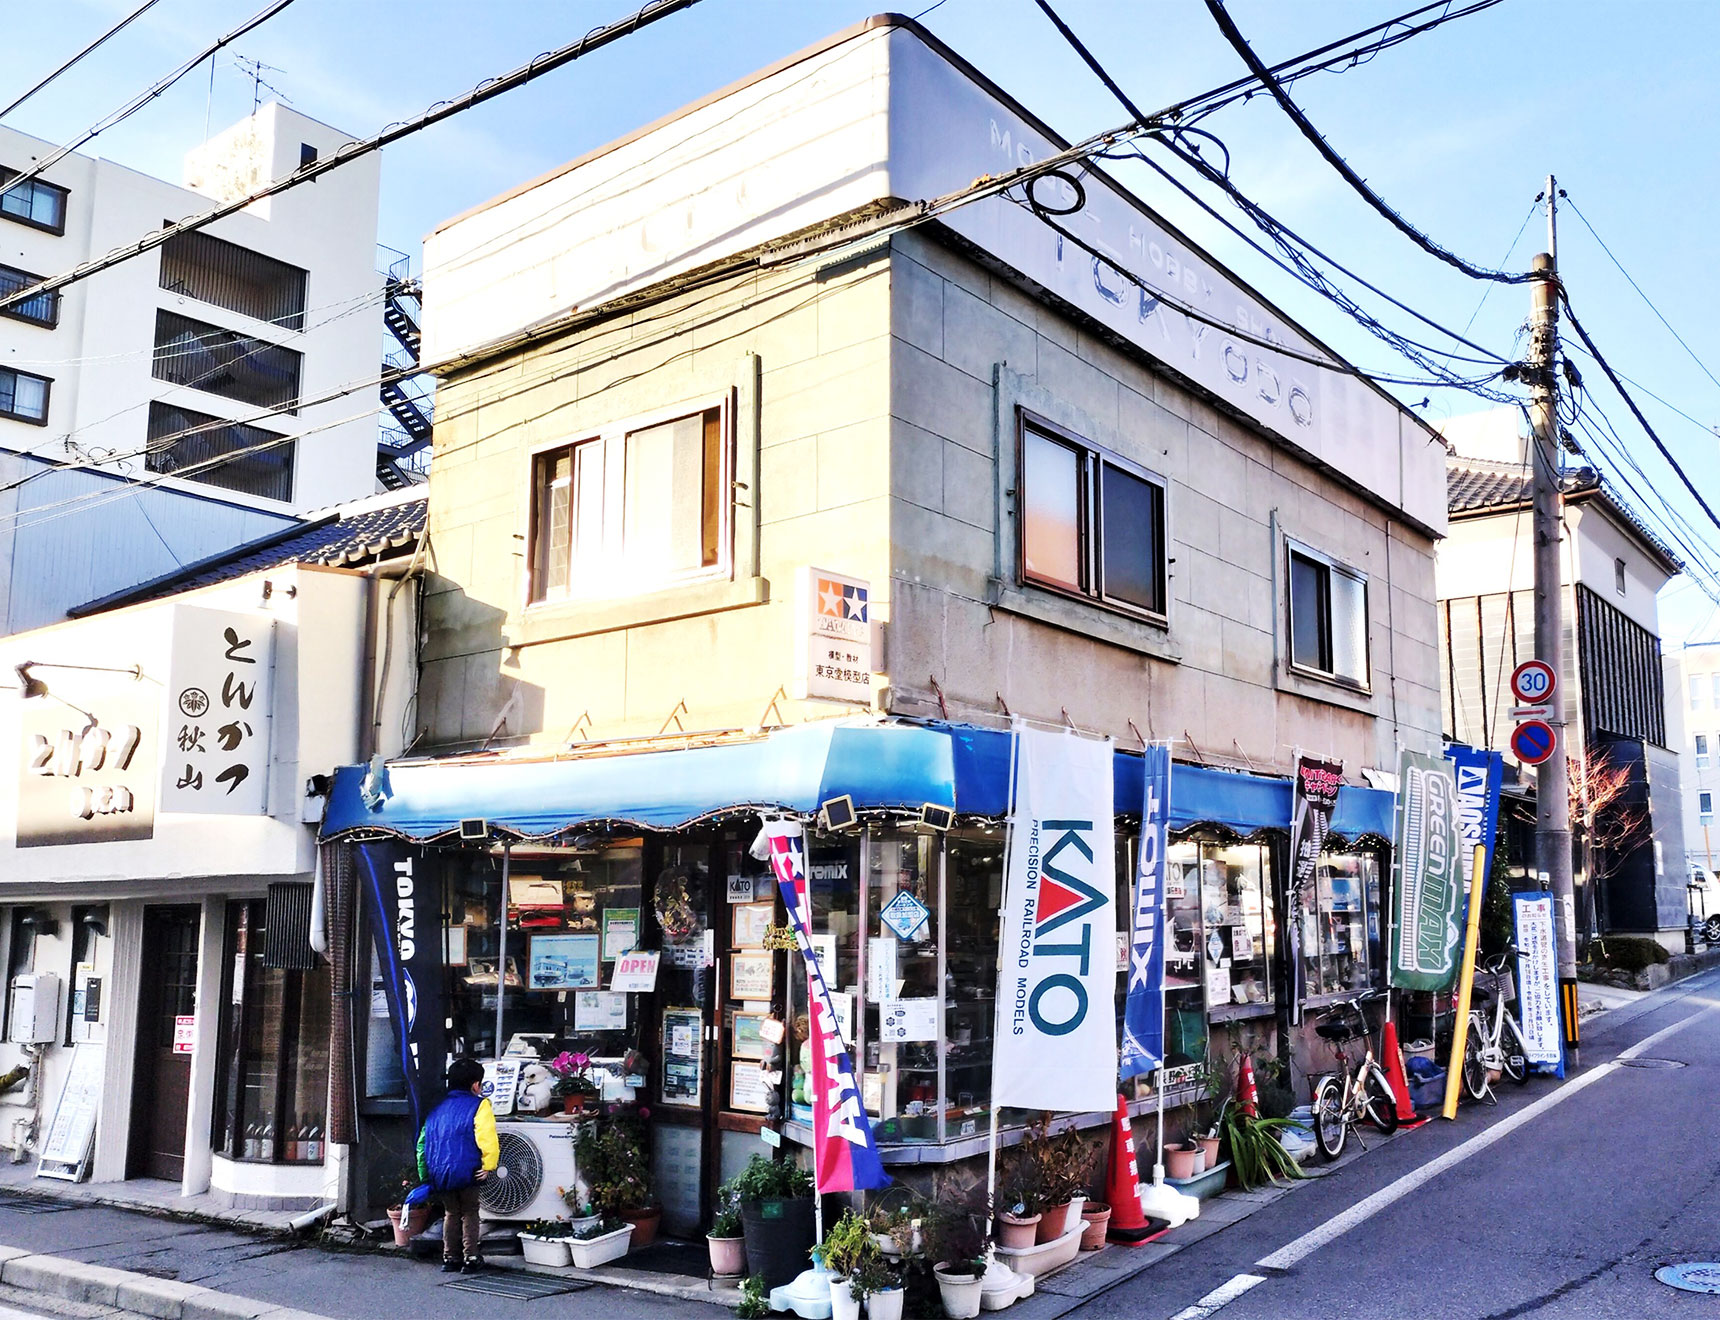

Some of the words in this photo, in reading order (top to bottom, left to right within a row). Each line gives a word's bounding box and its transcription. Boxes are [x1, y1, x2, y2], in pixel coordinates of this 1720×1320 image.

[1129, 225, 1213, 297] HOBBY
[815, 664, 870, 685] 東京堂模型店
[1521, 673, 1545, 692] 30
[215, 627, 256, 796] とんかつ
[176, 724, 206, 791] 秋山
[729, 878, 751, 892] KATO
[1025, 818, 1039, 889] PRECISION
[1129, 785, 1160, 993] TOMIX
[394, 856, 416, 961] TOKYO
[1018, 898, 1035, 969] RAILROAD
[1028, 819, 1110, 1036] KATO
[620, 959, 656, 973] OPEN
[1013, 977, 1028, 1036] MODELS
